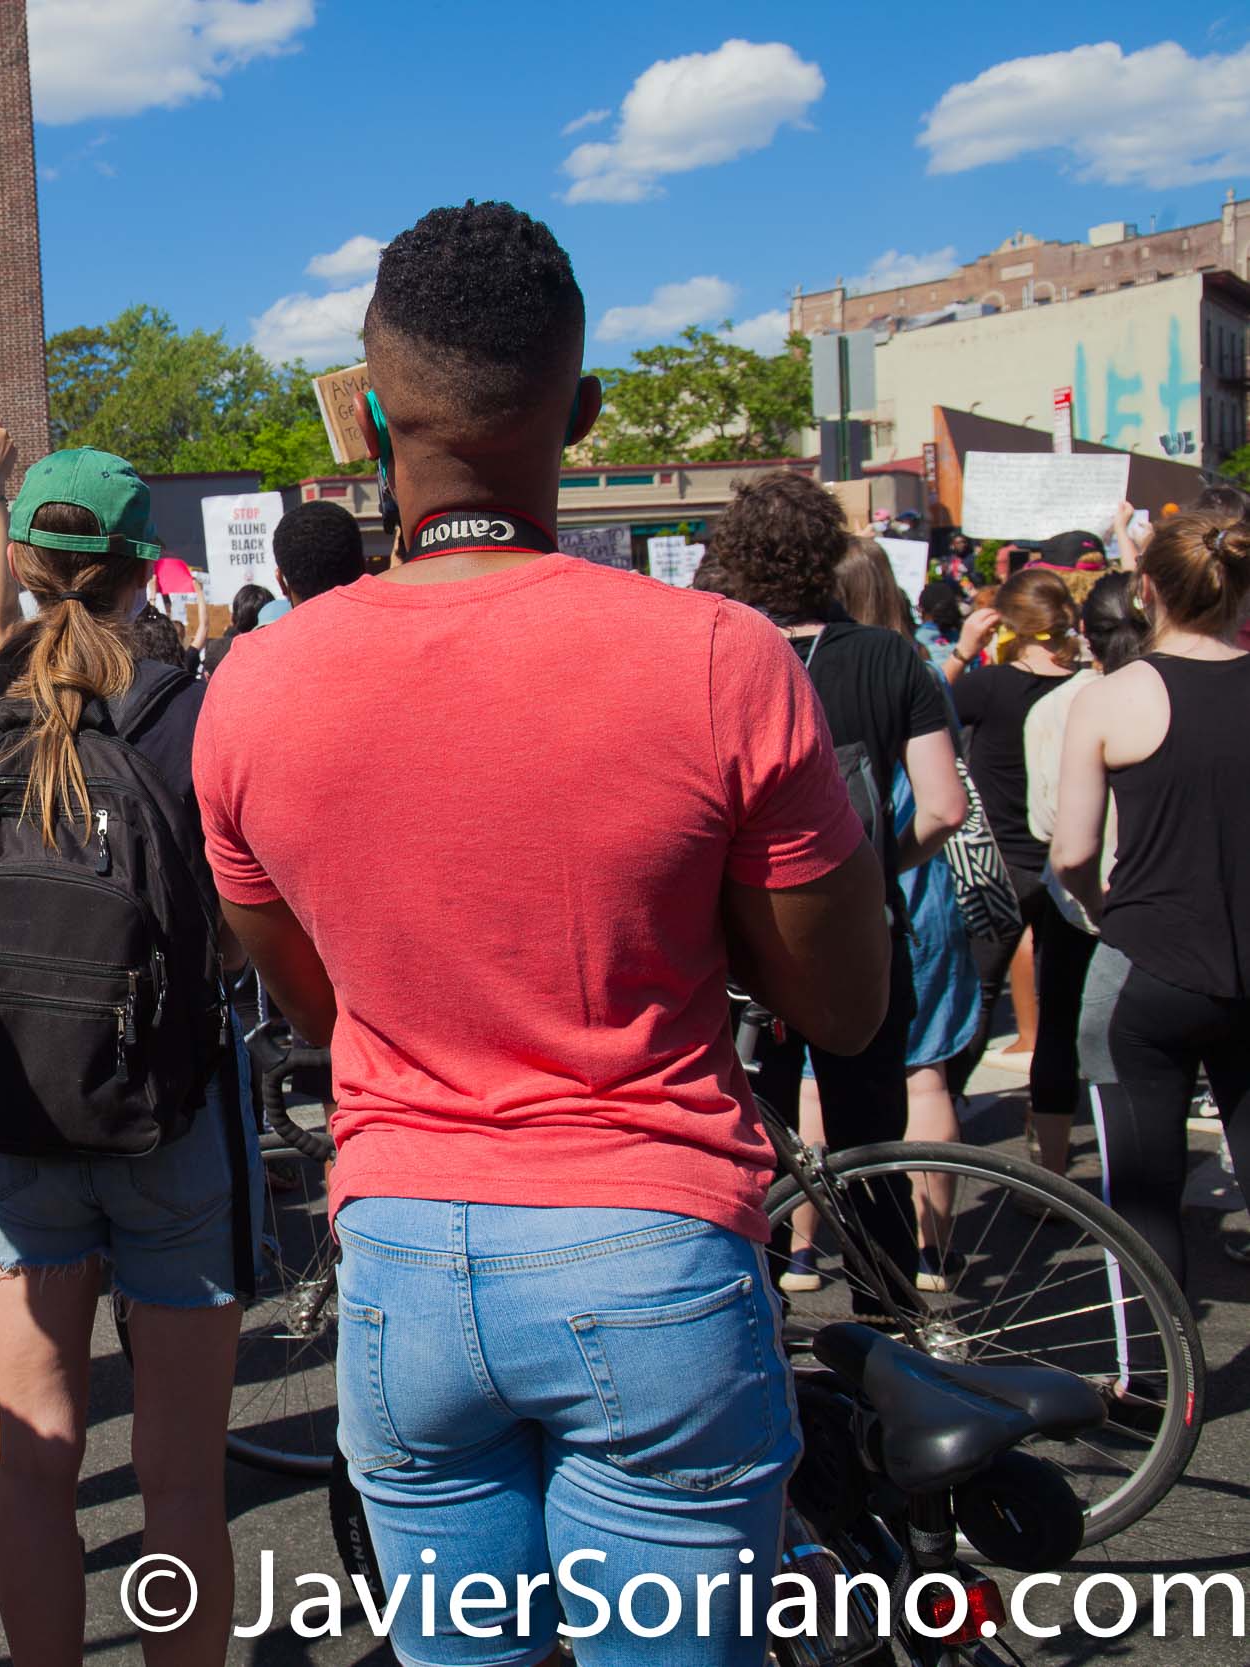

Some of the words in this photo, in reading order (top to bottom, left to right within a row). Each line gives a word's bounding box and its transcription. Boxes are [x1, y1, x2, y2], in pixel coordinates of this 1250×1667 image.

[233, 508, 261, 520] STOP
[228, 523, 267, 536] KILLING
[421, 519, 515, 547] Canon
[231, 539, 264, 551] BLACK
[230, 553, 265, 566] PEOPLE
